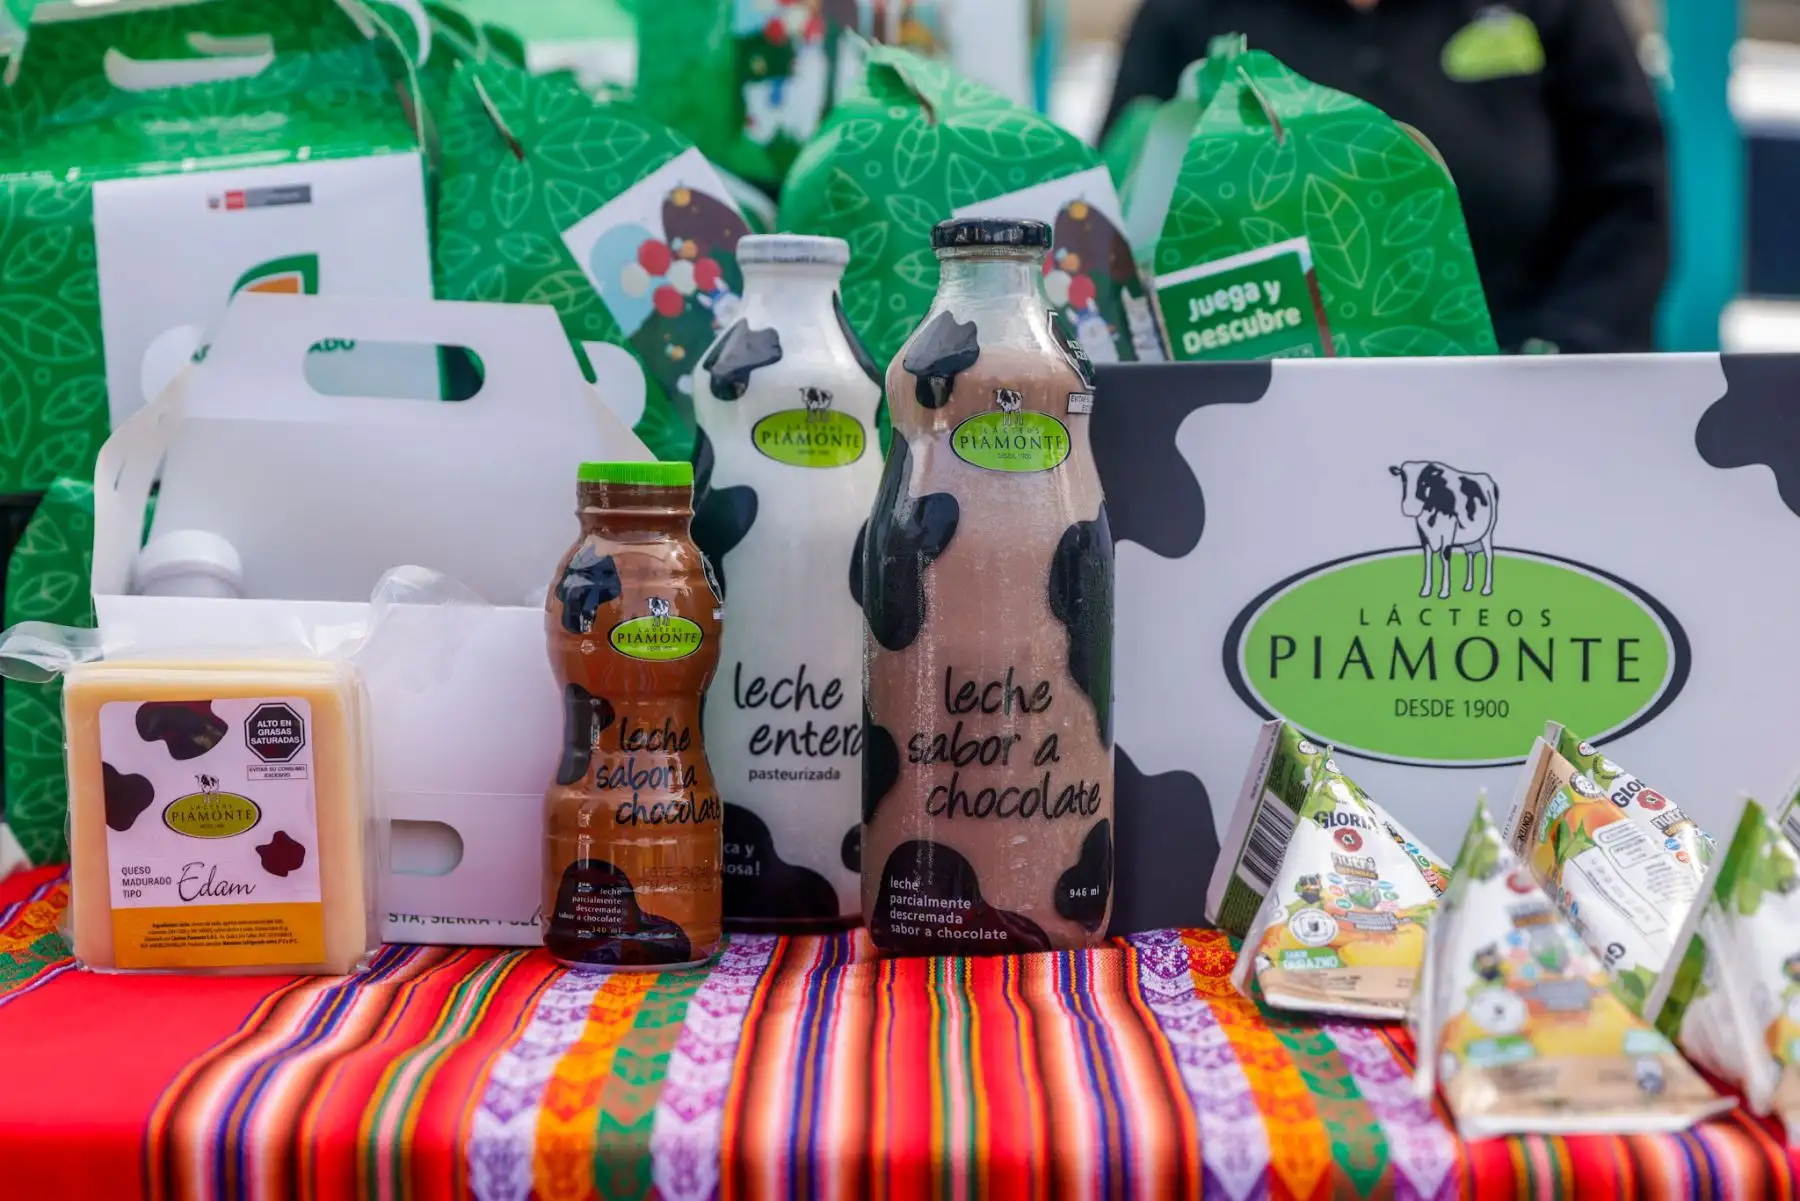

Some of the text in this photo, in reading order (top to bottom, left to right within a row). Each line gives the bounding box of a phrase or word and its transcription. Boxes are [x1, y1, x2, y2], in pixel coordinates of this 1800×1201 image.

[1188, 280, 1281, 323] Juega y
[1182, 307, 1302, 354] Descubre
[762, 430, 860, 448] PIAMONTE
[960, 435, 1063, 450] PIAMONTE
[1360, 603, 1552, 627] LÁCTEOS
[618, 633, 697, 643] PIAMONTE
[1268, 635, 1641, 683] PIAMONTE
[734, 661, 844, 712] leche
[944, 666, 1052, 716] leche
[1395, 699, 1510, 718] DESDE 1900
[250, 736, 300, 744] SATURADAS
[257, 728, 292, 736] GRASAS
[620, 717, 691, 752] leche
[908, 721, 1060, 767] sabor a
[596, 757, 697, 790] sabor a
[748, 767, 841, 782] pasteurizada
[926, 771, 1101, 819] chocolate
[171, 808, 252, 822] PIAMONTE
[121, 866, 151, 875] QUESO
[122, 877, 172, 886] MADURADO
[176, 861, 256, 901] Edam
[890, 876, 919, 890] leche
[123, 889, 142, 898] TIPO
[600, 887, 622, 895] leche
[1069, 885, 1100, 898] 946 ml
[572, 896, 622, 905] parcialmente
[576, 904, 621, 913] descremada
[889, 894, 972, 910] parcialmente
[583, 914, 622, 923] chocolate
[890, 908, 963, 925] descremada
[890, 922, 1008, 940] sabor a chocolate
